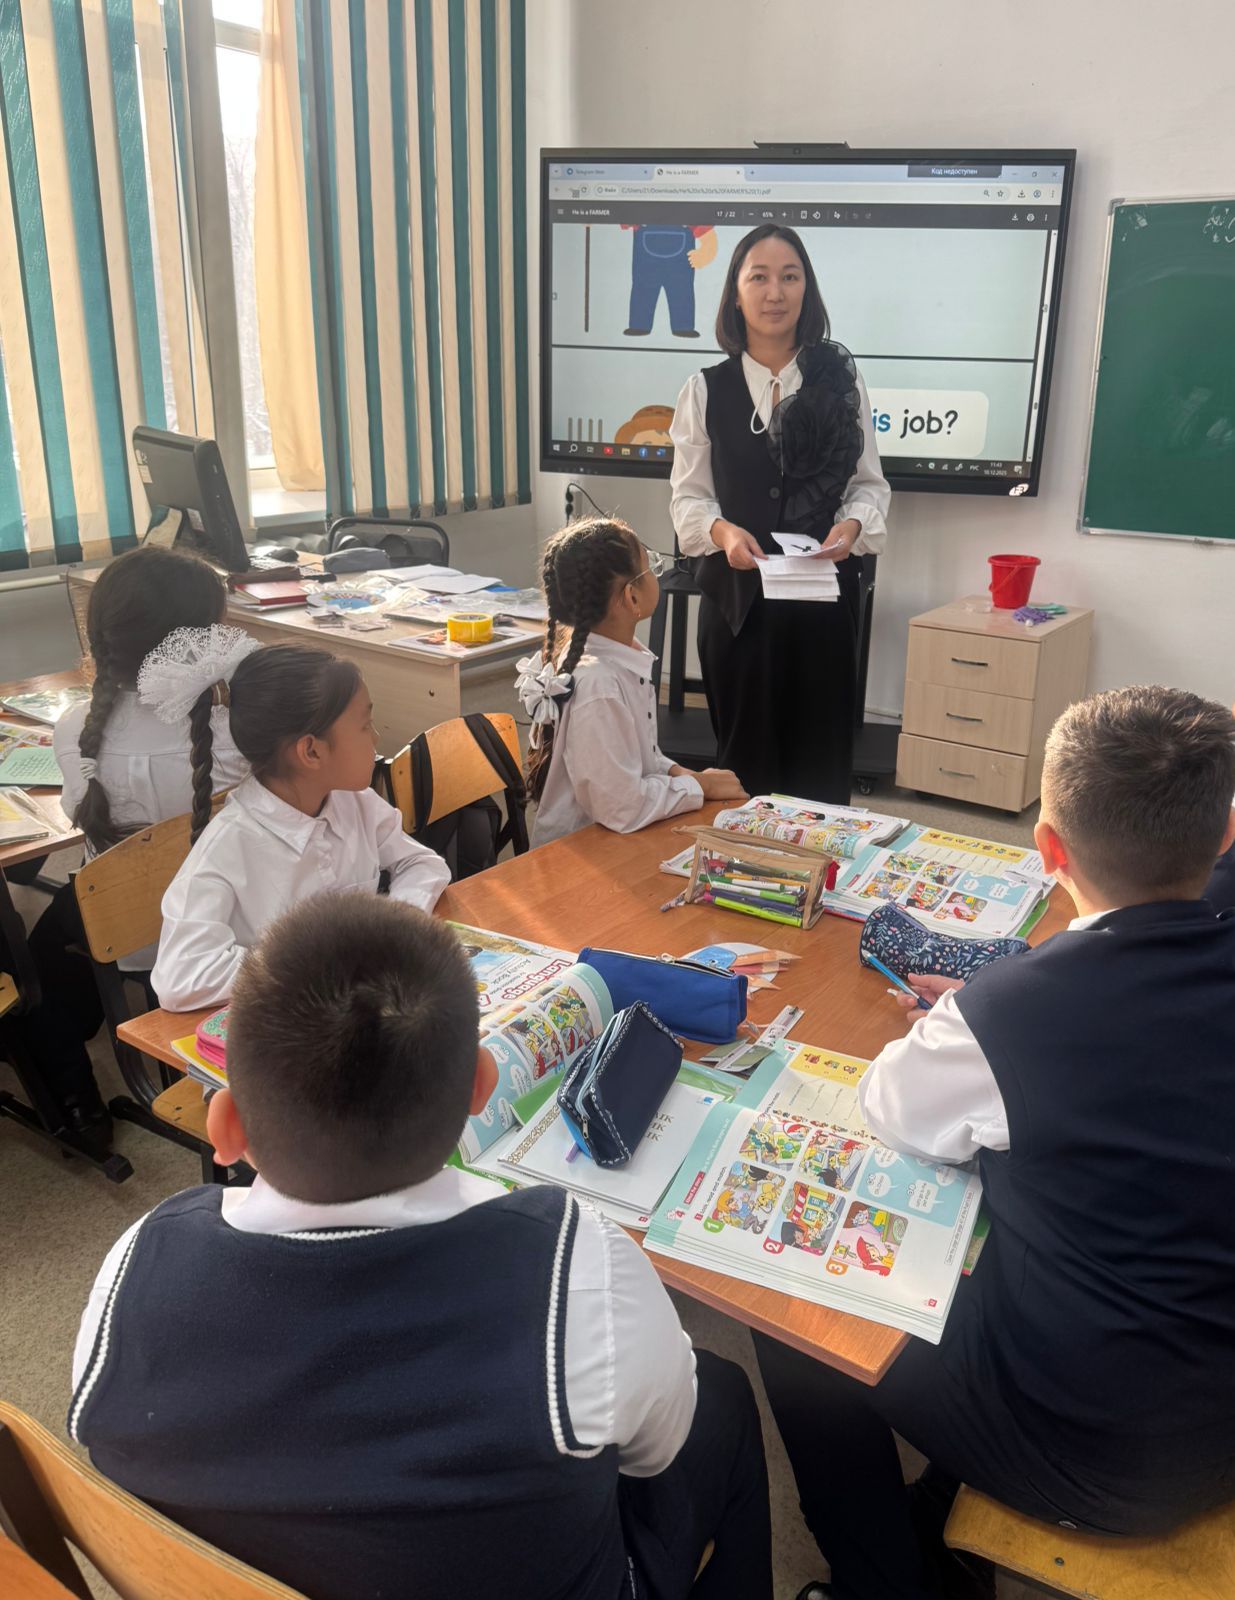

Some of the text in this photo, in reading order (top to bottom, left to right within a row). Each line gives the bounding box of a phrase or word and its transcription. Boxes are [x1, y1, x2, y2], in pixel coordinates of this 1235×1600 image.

[899, 409, 958, 439] job?
[502, 959, 572, 1000] Language
[765, 1241, 781, 1253] 2
[828, 1263, 843, 1273] 3
